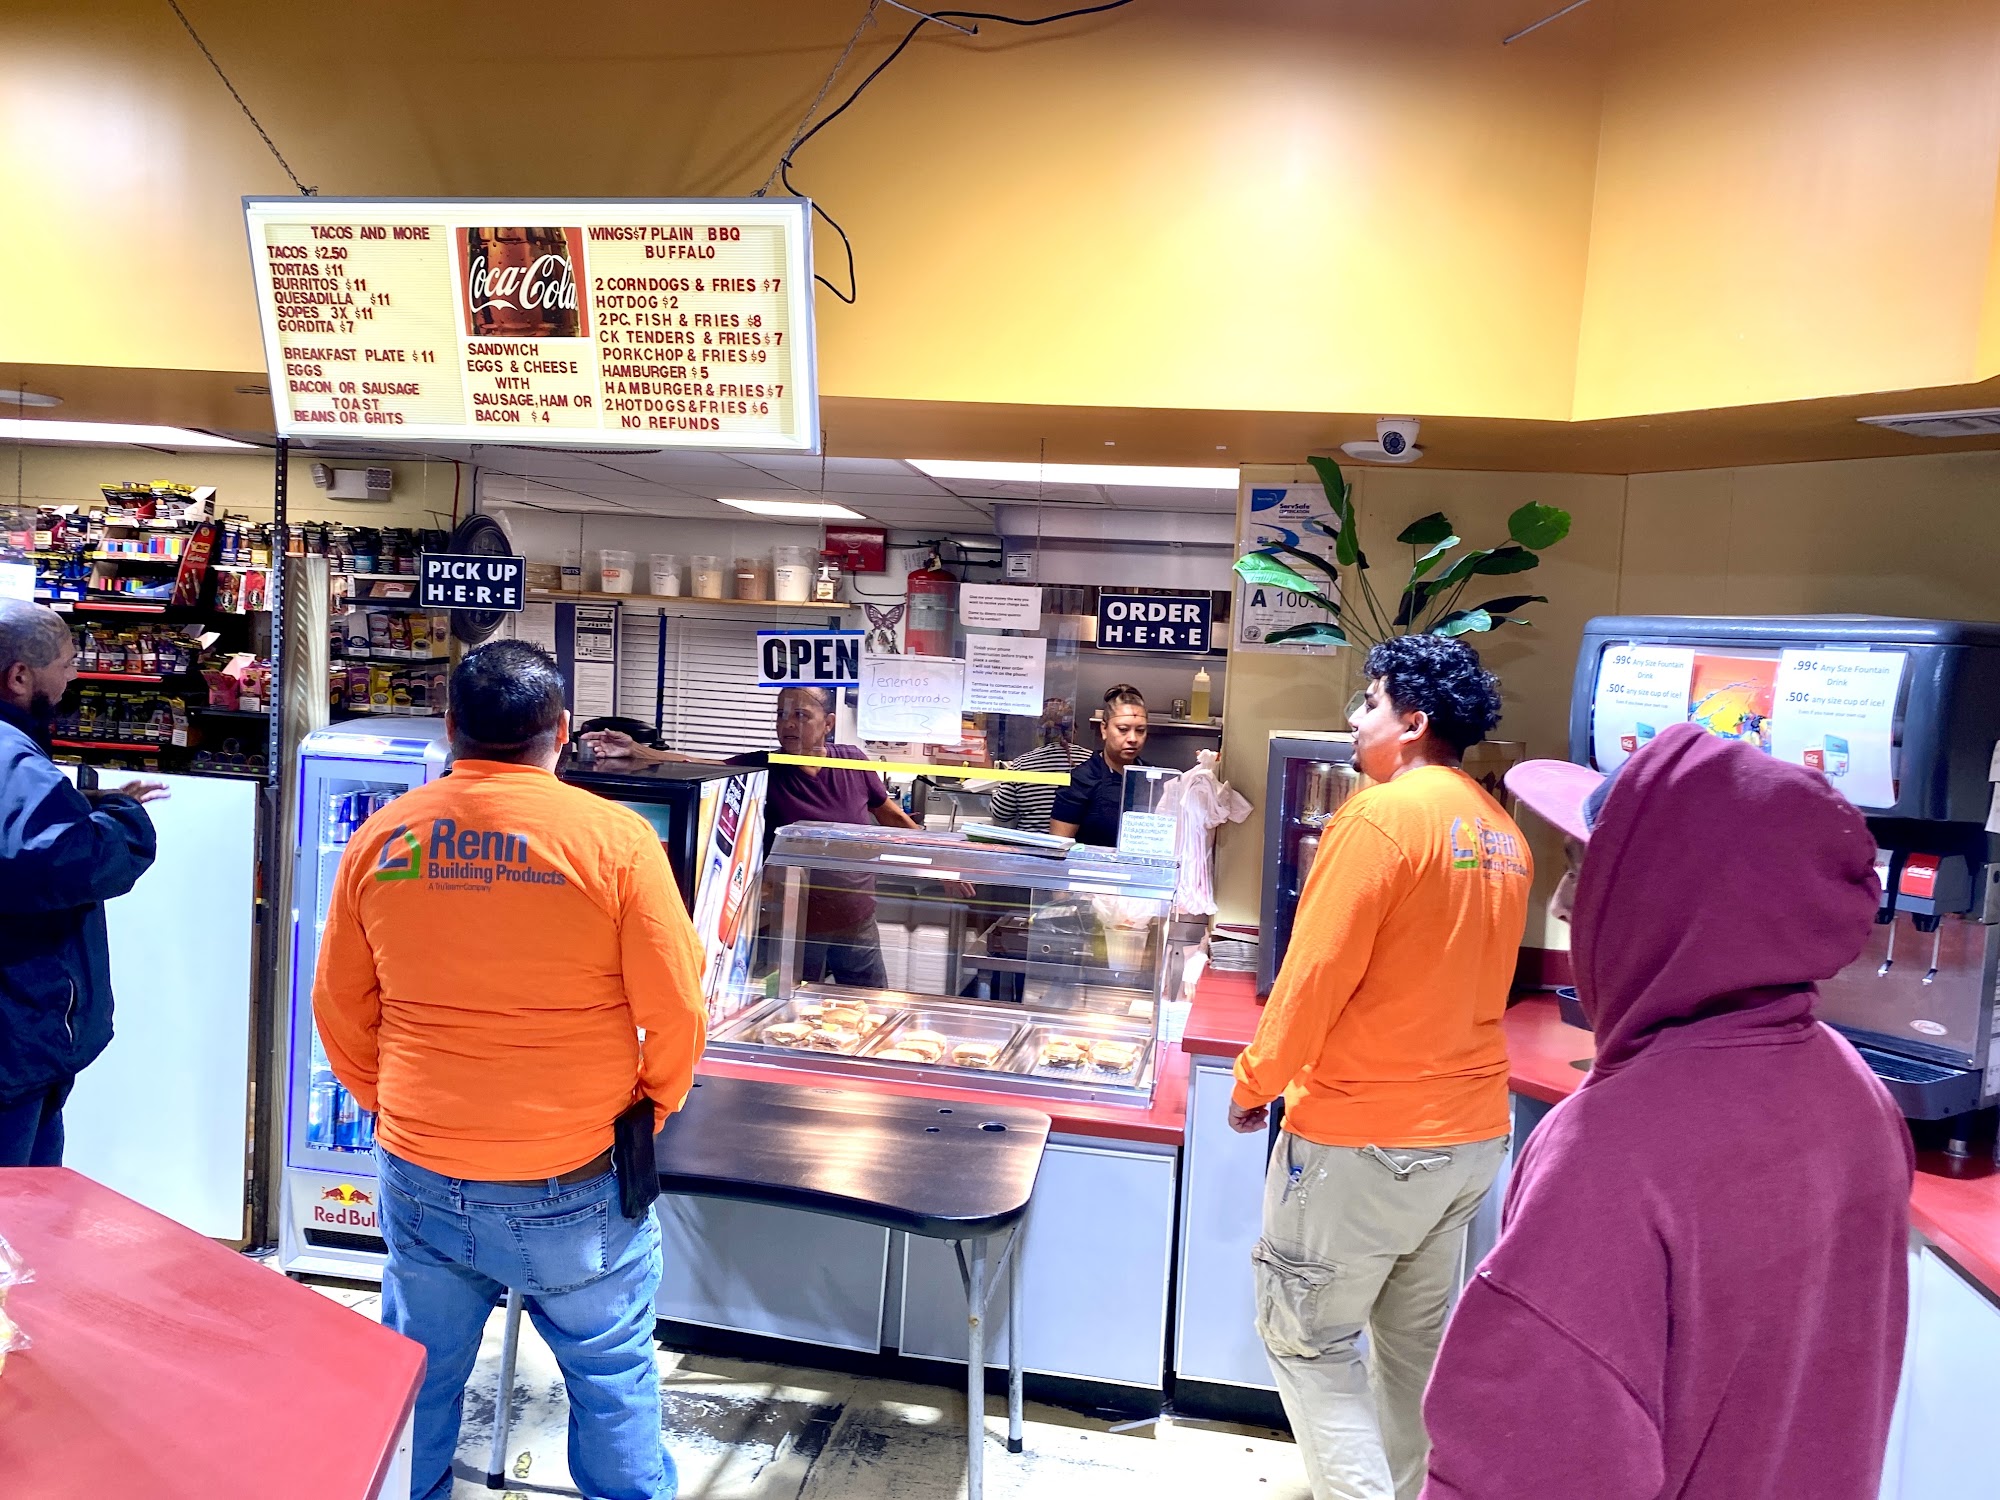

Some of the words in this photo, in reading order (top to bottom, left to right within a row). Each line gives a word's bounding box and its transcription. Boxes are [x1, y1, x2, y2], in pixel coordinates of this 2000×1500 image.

[311, 226, 353, 239] TACOS
[360, 227, 386, 239] AND
[393, 227, 429, 240] MORE
[651, 227, 693, 240] PLAIN
[708, 227, 740, 240] BBQ
[267, 246, 307, 258] TACOS
[645, 246, 715, 259] BUFFALO
[269, 263, 319, 276] TORTAS
[273, 277, 338, 290] BURRITOS
[469, 254, 577, 313] Coca-Cola
[596, 278, 603, 290] 2
[608, 278, 689, 291] CORNDOGS
[696, 278, 704, 291] &
[713, 279, 756, 292] FRIES
[275, 291, 353, 305] QUESADILLA
[277, 306, 319, 318] SOPES
[331, 307, 348, 319] 3X
[278, 320, 335, 332] GORDITA
[636, 314, 671, 326] FISH
[679, 314, 687, 326] &
[695, 314, 739, 327] FRIES
[600, 330, 619, 342] CK
[626, 331, 694, 344] TENDERS
[704, 332, 712, 344] &
[719, 332, 761, 345] FRIES
[284, 348, 356, 360] BREAKFAST
[365, 349, 405, 361] PLATE
[468, 343, 538, 355] SANDWICH
[603, 348, 683, 361] PORKCHOP
[688, 349, 696, 361] &
[703, 349, 747, 362] FRIES
[287, 364, 322, 376] EGGS
[467, 360, 502, 372] EGGS
[511, 361, 519, 372] &
[524, 361, 577, 373] CHEESE
[603, 365, 686, 378] HAMBURGER
[290, 380, 331, 392] BACON
[339, 382, 355, 393] OR
[362, 382, 419, 395] SAUSAGE
[495, 377, 529, 389] WITH
[606, 382, 702, 395] HAMBURGER
[706, 384, 714, 396] &
[720, 384, 764, 397] FRIES
[332, 398, 379, 410] TOAST
[574, 395, 592, 407] OR
[294, 410, 335, 422] BEANS
[340, 412, 357, 423] OR
[365, 412, 403, 424] GRITS
[476, 410, 519, 422] BACON
[622, 416, 640, 428] NO
[649, 417, 719, 430] REFUNDS
[428, 560, 481, 580] PICK
[487, 563, 517, 582] UP
[1251, 589, 1267, 607] A
[1107, 601, 1201, 623] ORDER
[763, 638, 858, 680] OPEN
[1633, 659, 1643, 667] Any
[866, 663, 929, 687] Tenemos
[1820, 665, 1835, 673] Any
[1854, 666, 1890, 674] Fountain
[867, 693, 951, 706] Champurrado
[1812, 697, 1825, 705] any
[1828, 697, 1842, 705] size
[1870, 699, 1885, 707] ice!
[429, 818, 528, 863] Renn
[428, 862, 492, 884] Building
[496, 866, 567, 885] Products
[314, 1205, 346, 1225] Red
